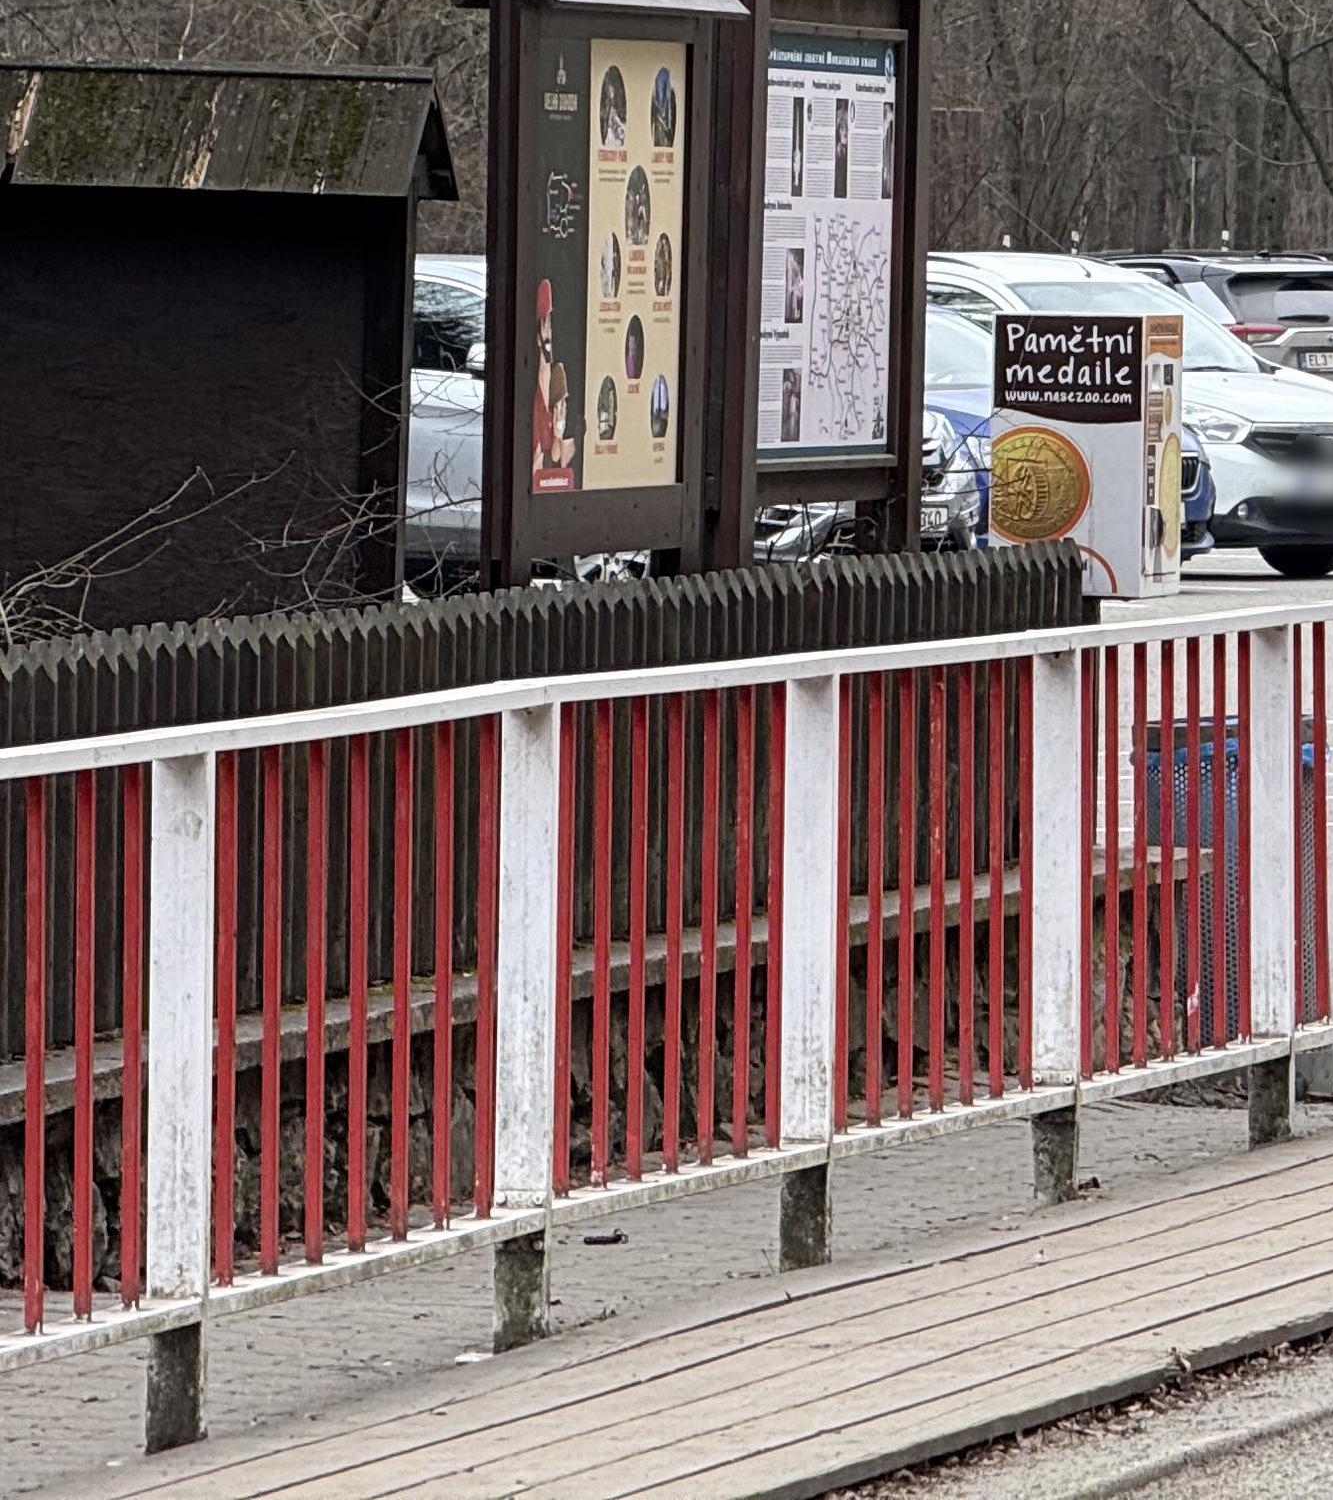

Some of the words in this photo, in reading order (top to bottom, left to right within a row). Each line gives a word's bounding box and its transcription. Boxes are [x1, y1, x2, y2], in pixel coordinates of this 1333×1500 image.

[1006, 323, 1134, 354] Pamětní
[1005, 356, 1132, 386] medaile
[1005, 390, 1132, 404] www.nasezoo.com
